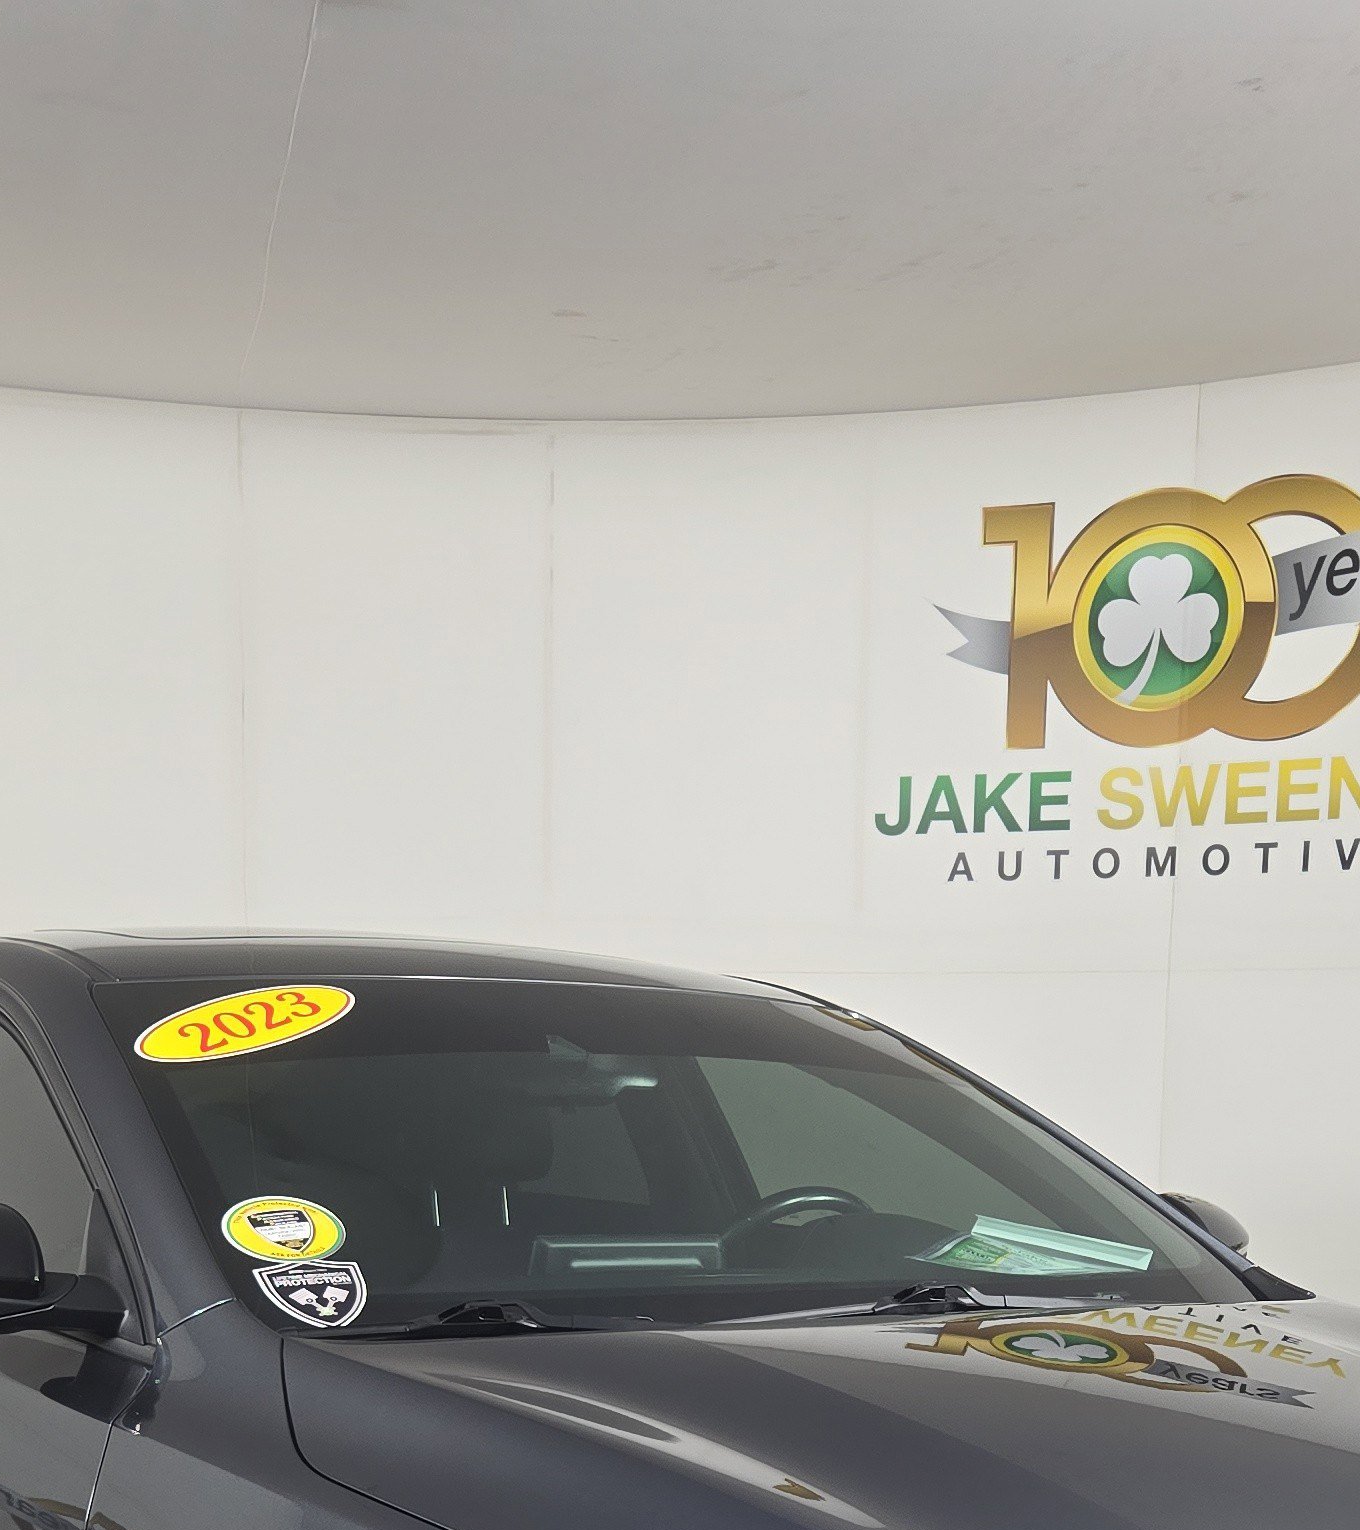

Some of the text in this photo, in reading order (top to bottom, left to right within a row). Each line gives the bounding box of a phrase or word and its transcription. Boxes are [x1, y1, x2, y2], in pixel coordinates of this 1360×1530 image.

[874, 769, 1072, 836] JAKE
[178, 991, 322, 1053] 2023
[273, 1275, 353, 1288] PROTECTION
